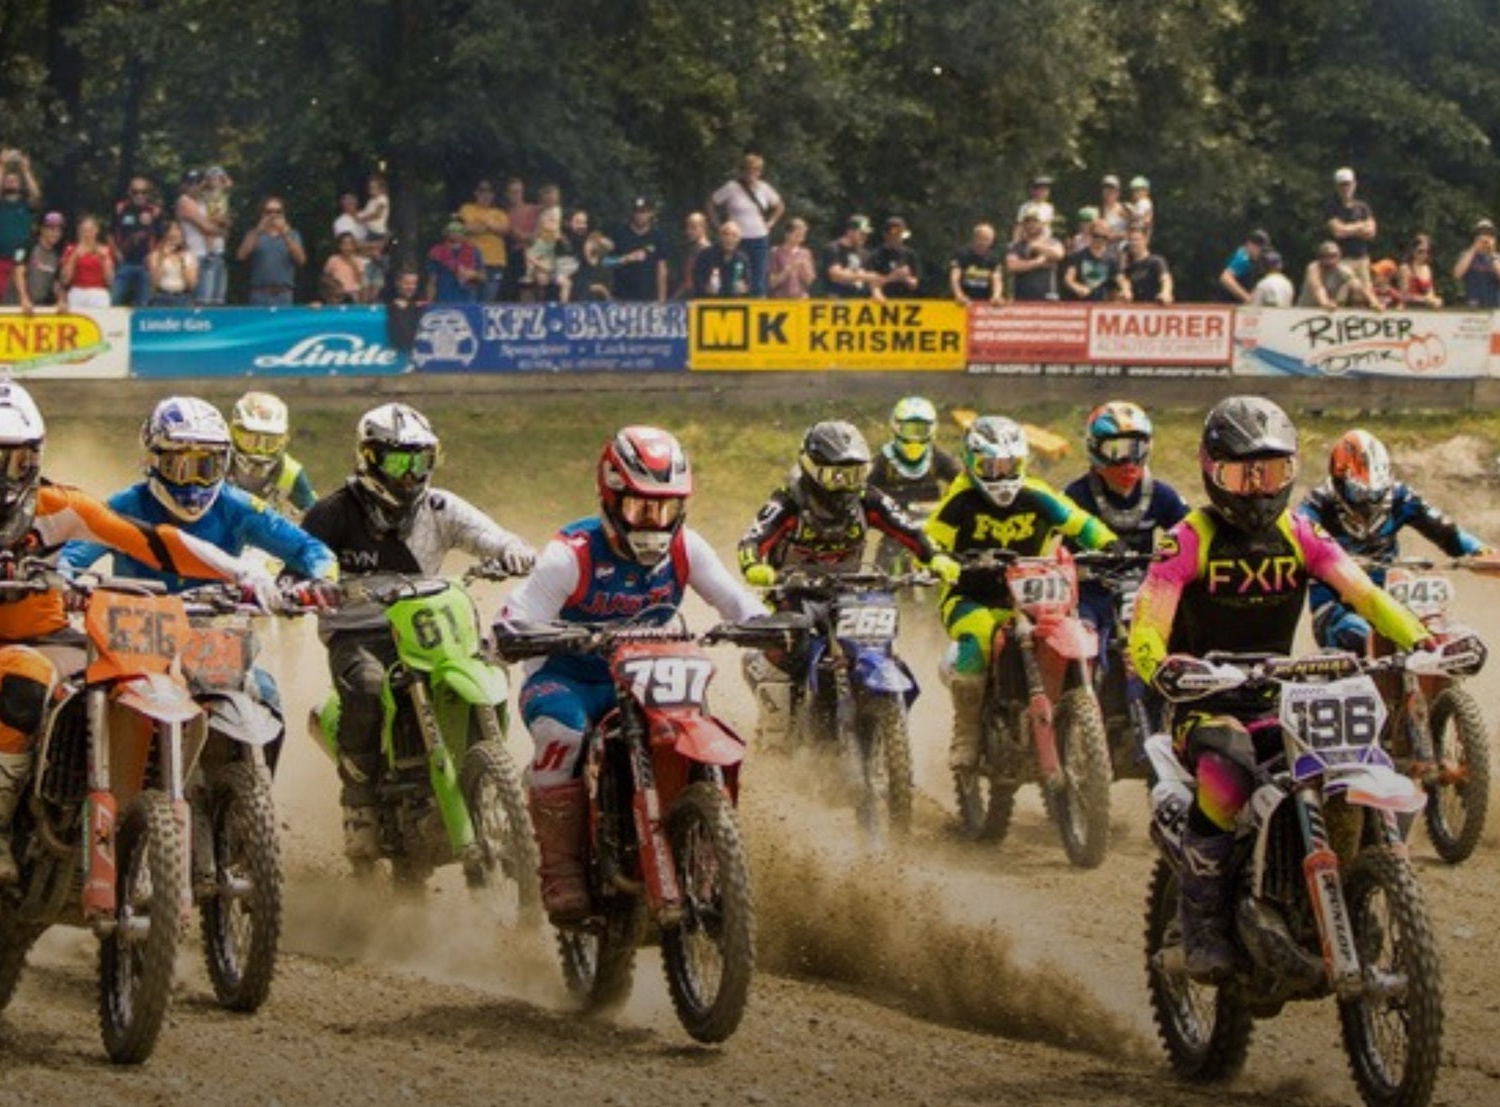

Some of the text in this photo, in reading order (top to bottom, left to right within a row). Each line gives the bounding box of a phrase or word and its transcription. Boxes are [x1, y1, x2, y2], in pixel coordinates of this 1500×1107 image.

[483, 303, 688, 339] KFZ BACHER
[758, 312, 789, 345] K
[809, 304, 922, 328] FRANZ
[1096, 313, 1224, 338] MAURER
[254, 334, 398, 367] Linde
[809, 331, 960, 353] KRISMER
[1209, 556, 1297, 593] FXR
[411, 604, 462, 650] 61
[836, 607, 897, 638] 269
[623, 658, 714, 707] 797
[1291, 697, 1377, 748] 196
